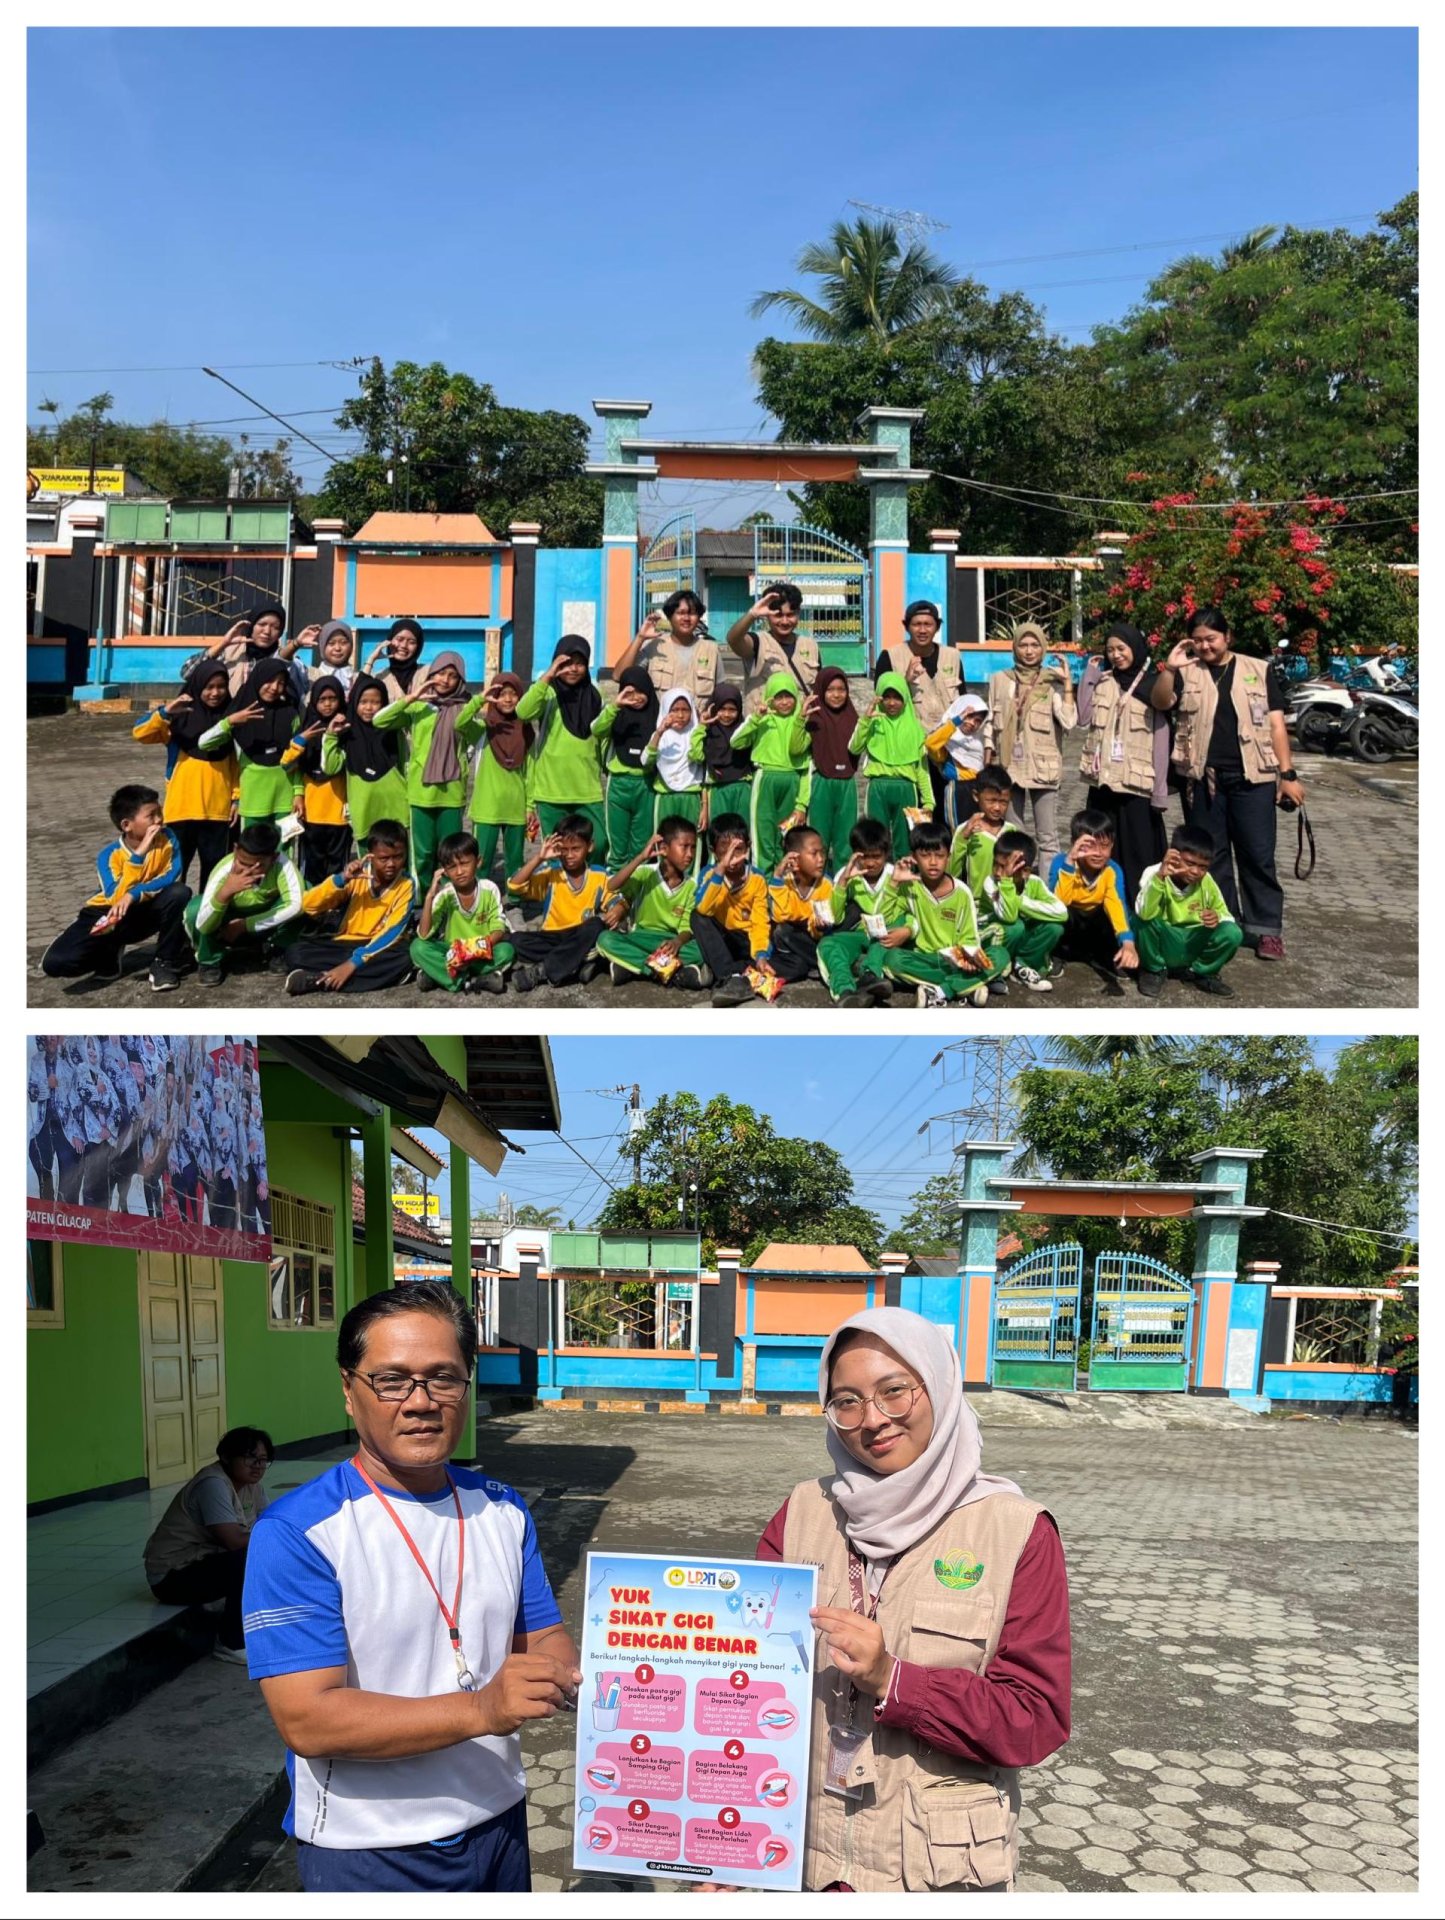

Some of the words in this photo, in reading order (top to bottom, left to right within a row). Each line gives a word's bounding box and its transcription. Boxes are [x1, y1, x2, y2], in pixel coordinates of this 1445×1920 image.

[56, 1214, 91, 1229] CILACAP
[688, 1571, 716, 1585] LPPM
[610, 1588, 650, 1604] YUK
[609, 1610, 666, 1626] SIKAT
[674, 1614, 713, 1629] GIGI
[608, 1632, 686, 1649] DENGAN
[694, 1636, 757, 1654] BENAR
[618, 1654, 684, 1665] langkah-langkah
[686, 1658, 720, 1667] menyikat
[722, 1660, 738, 1668] gigi
[760, 1662, 786, 1670] benar!
[642, 1670, 647, 1680] 1
[735, 1674, 743, 1684] 2
[650, 1688, 668, 1696] pasta
[636, 1739, 644, 1749] 3
[729, 1746, 739, 1756] 4
[634, 1804, 642, 1814] 5
[724, 1812, 734, 1822] 6
[644, 1829, 680, 1837] Mencungkil
